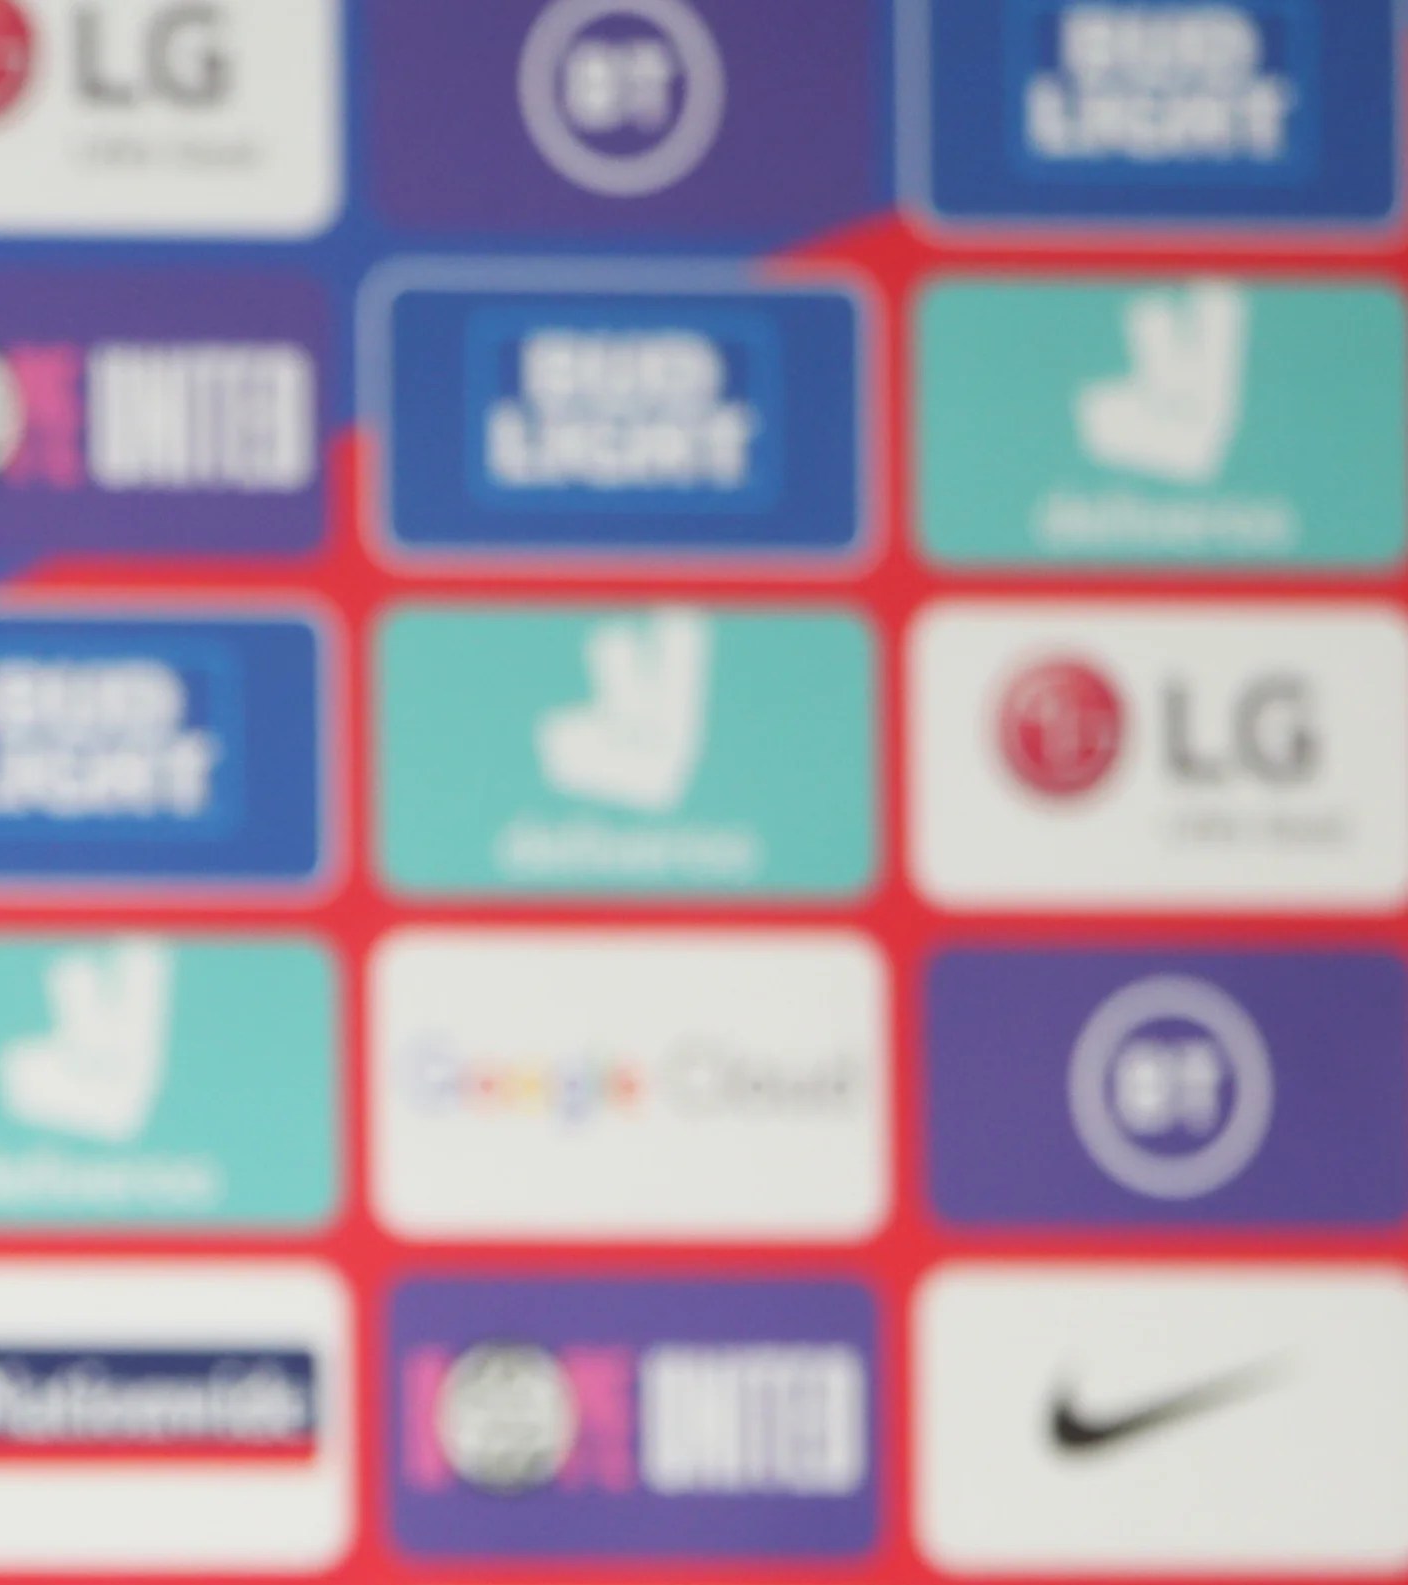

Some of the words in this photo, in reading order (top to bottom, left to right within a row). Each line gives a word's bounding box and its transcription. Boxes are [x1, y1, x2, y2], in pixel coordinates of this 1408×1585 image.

[73, 2, 227, 105] LG
[564, 40, 671, 132] BT
[1063, 6, 1259, 76] BUD
[1025, 76, 1291, 160] LIGHT
[521, 330, 721, 402] BUD
[87, 345, 315, 490] UNITED
[486, 401, 751, 488] LIGHT
[1163, 674, 1319, 784] LG
[399, 1030, 645, 1129] Google
[1112, 1036, 1221, 1135] BT
[641, 1343, 867, 1497] UNITED
